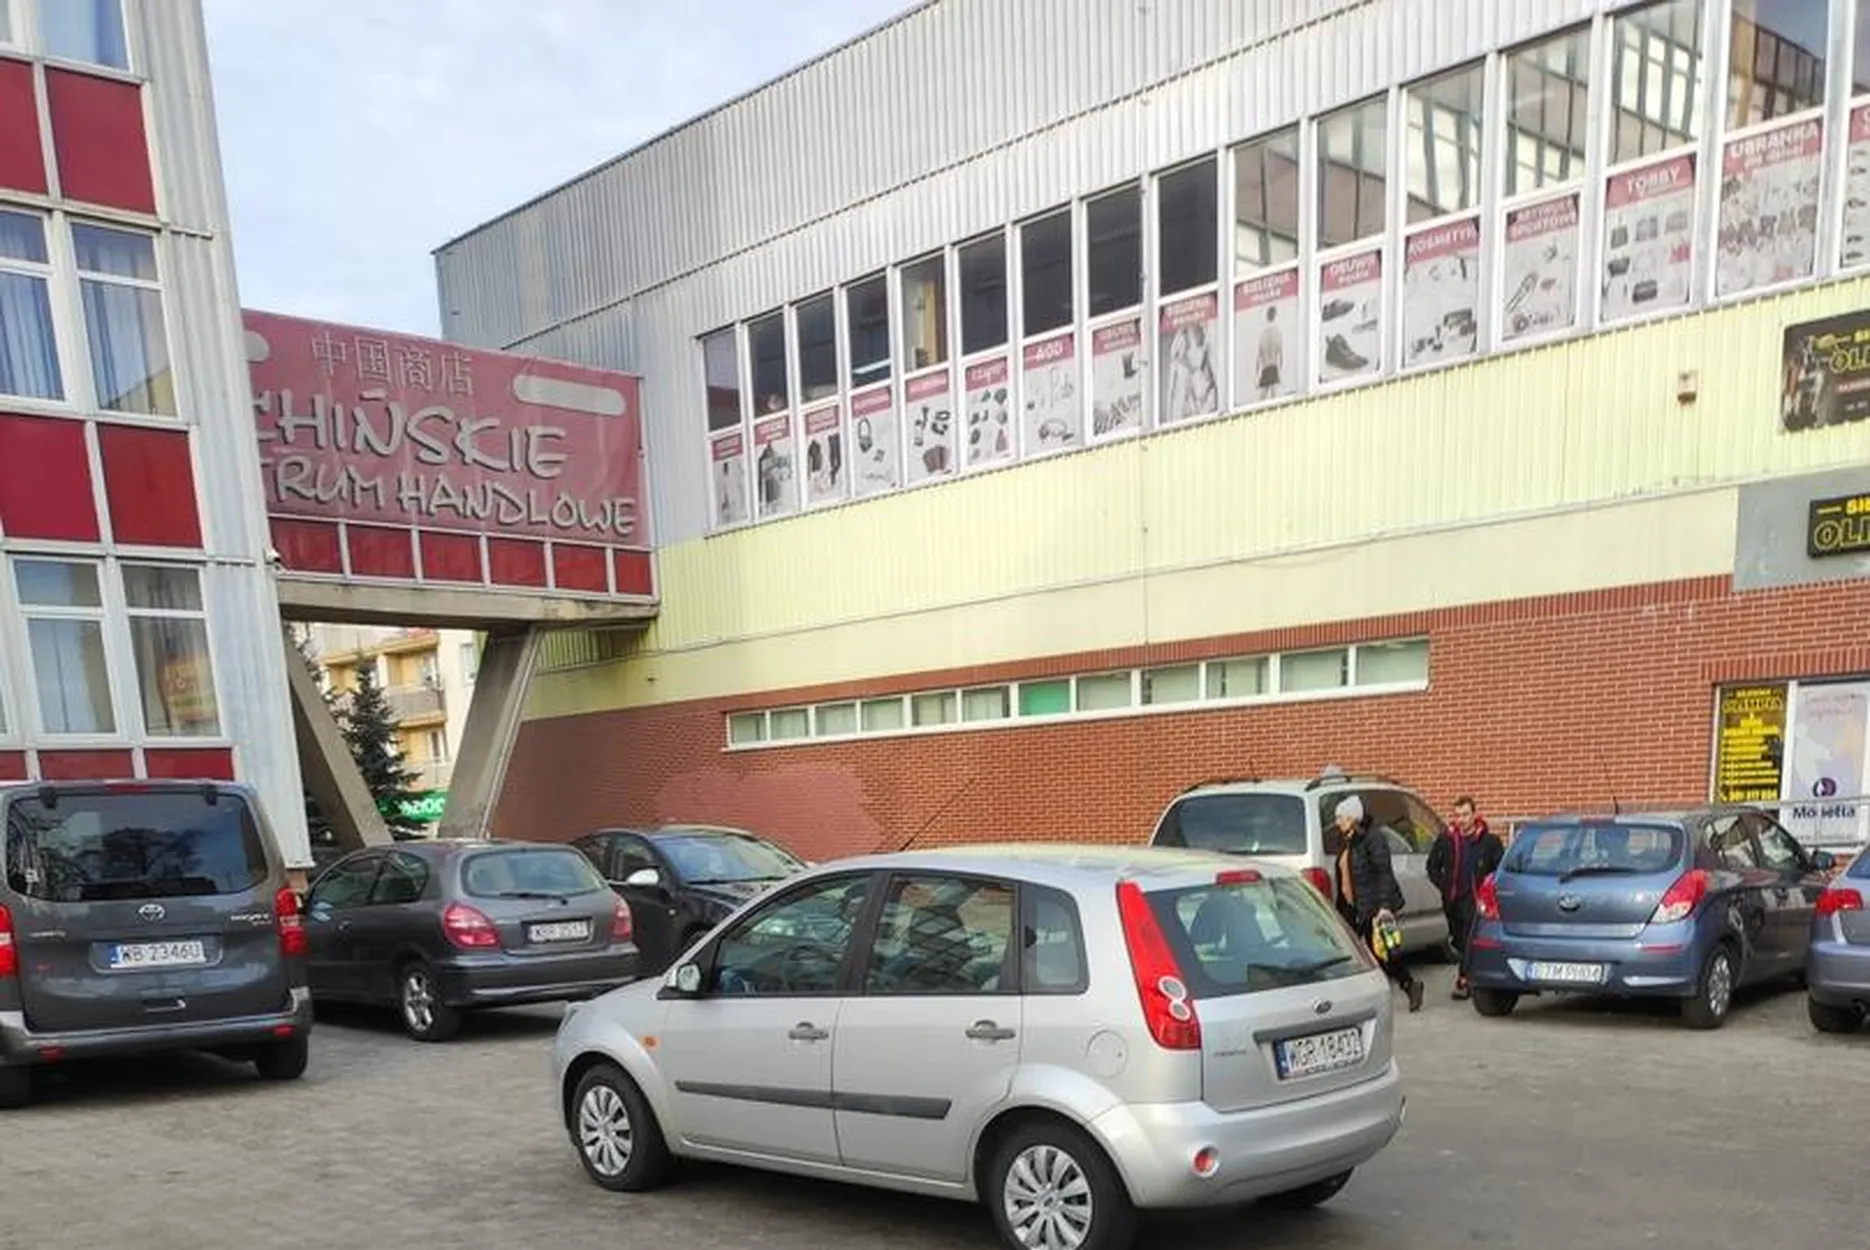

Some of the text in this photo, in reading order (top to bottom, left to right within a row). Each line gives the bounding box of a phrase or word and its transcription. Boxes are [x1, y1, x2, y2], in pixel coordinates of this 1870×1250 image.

[311, 331, 474, 396] 中国商店
[397, 472, 637, 536] HANDLOWE
